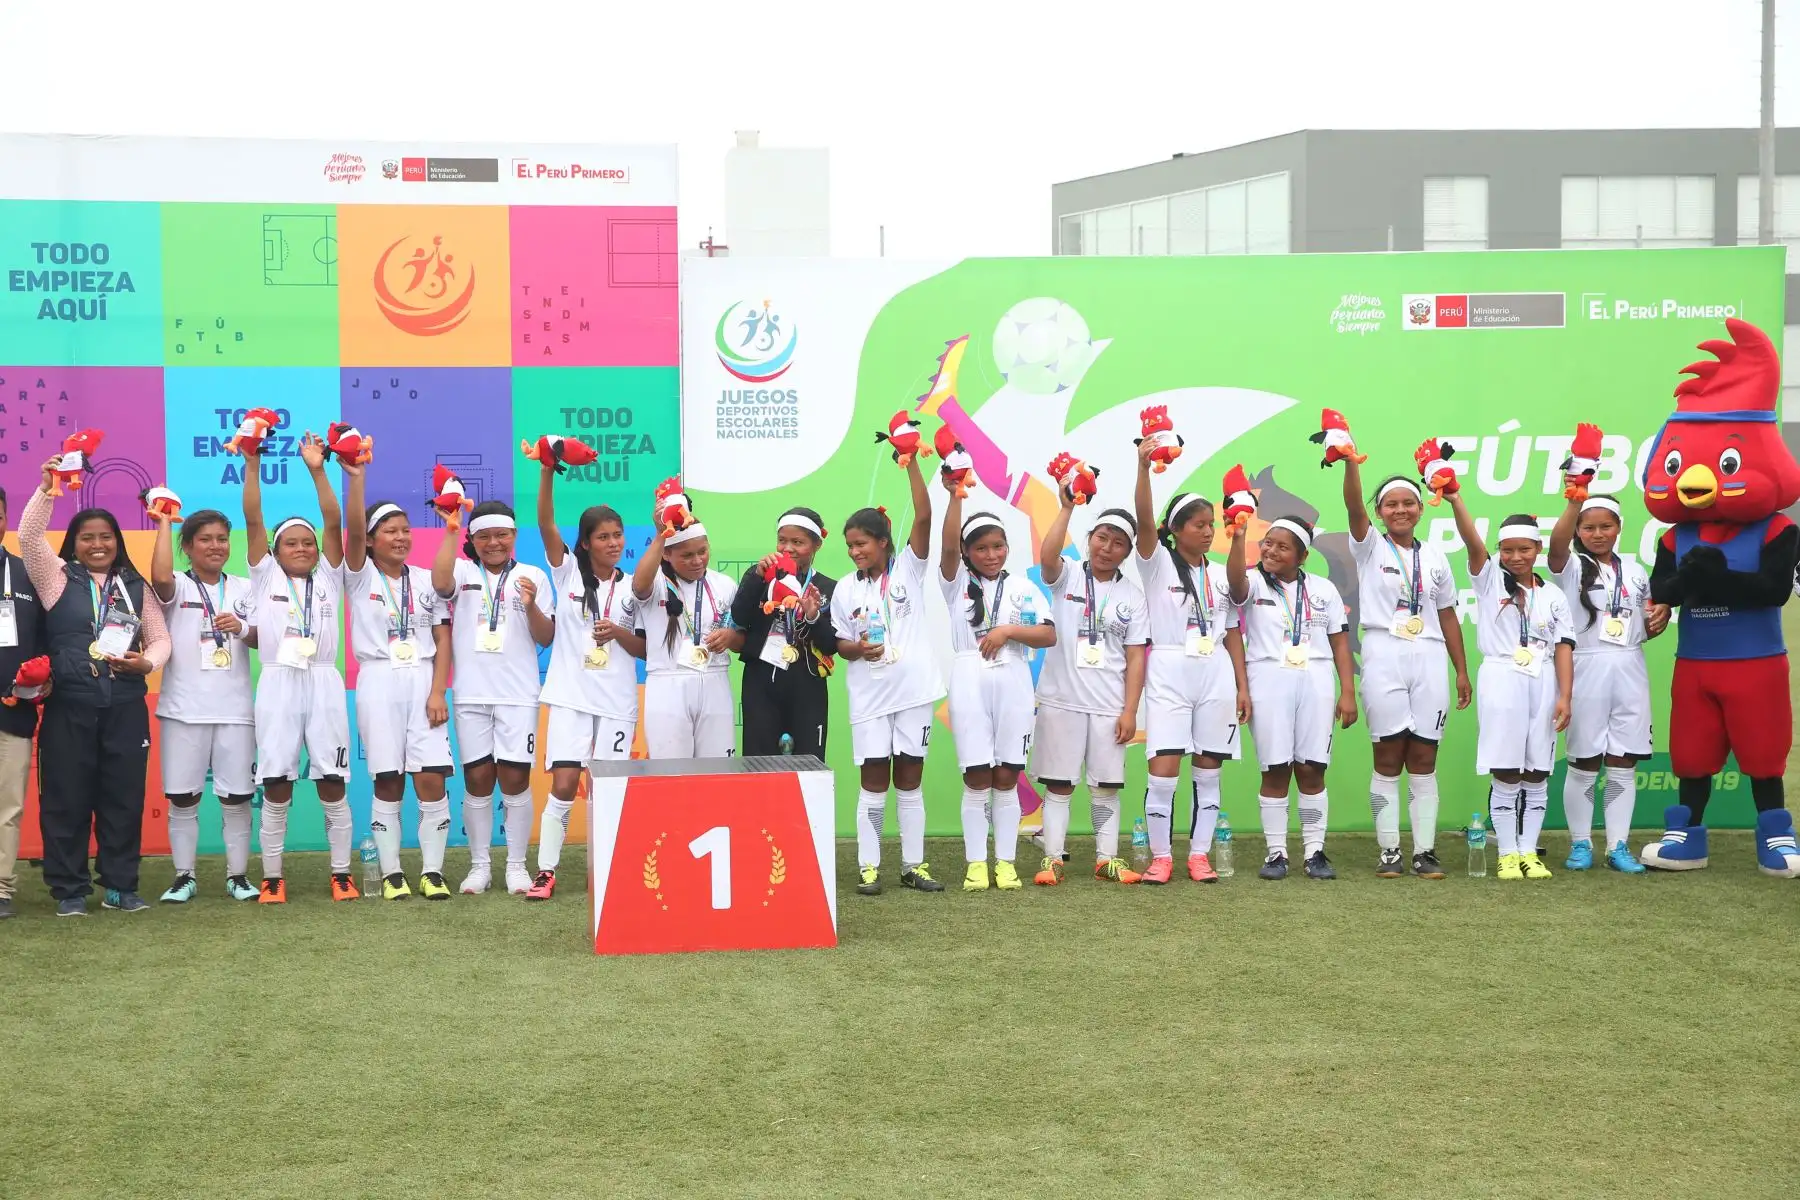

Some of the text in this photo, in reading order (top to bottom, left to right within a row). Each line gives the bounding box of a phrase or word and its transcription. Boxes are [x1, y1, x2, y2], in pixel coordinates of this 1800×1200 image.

[31, 242, 109, 265] TODO
[9, 270, 135, 293] EMPIEZA
[37, 293, 107, 322] AQUÍ
[1440, 306, 1463, 317] PERÚ
[1473, 307, 1510, 315] Ministerio
[1662, 299, 1736, 319] PRIMERO
[1484, 314, 1520, 323] Educación
[717, 389, 798, 405] JUEGOS
[560, 407, 633, 429] TODO
[716, 406, 799, 416] DEPORTIVOS
[716, 417, 799, 428] ESCOLARES
[540, 434, 657, 455] PIEZA
[716, 429, 799, 439] NACIONALES
[193, 436, 308, 457] EMEZ
[565, 456, 630, 484] AQUÍ
[527, 733, 535, 754] 8
[613, 731, 625, 752] 2
[817, 724, 823, 747] 1
[1228, 724, 1237, 744] 7
[335, 746, 348, 768] 10
[1712, 771, 1740, 790] 19
[688, 826, 732, 910] 1
